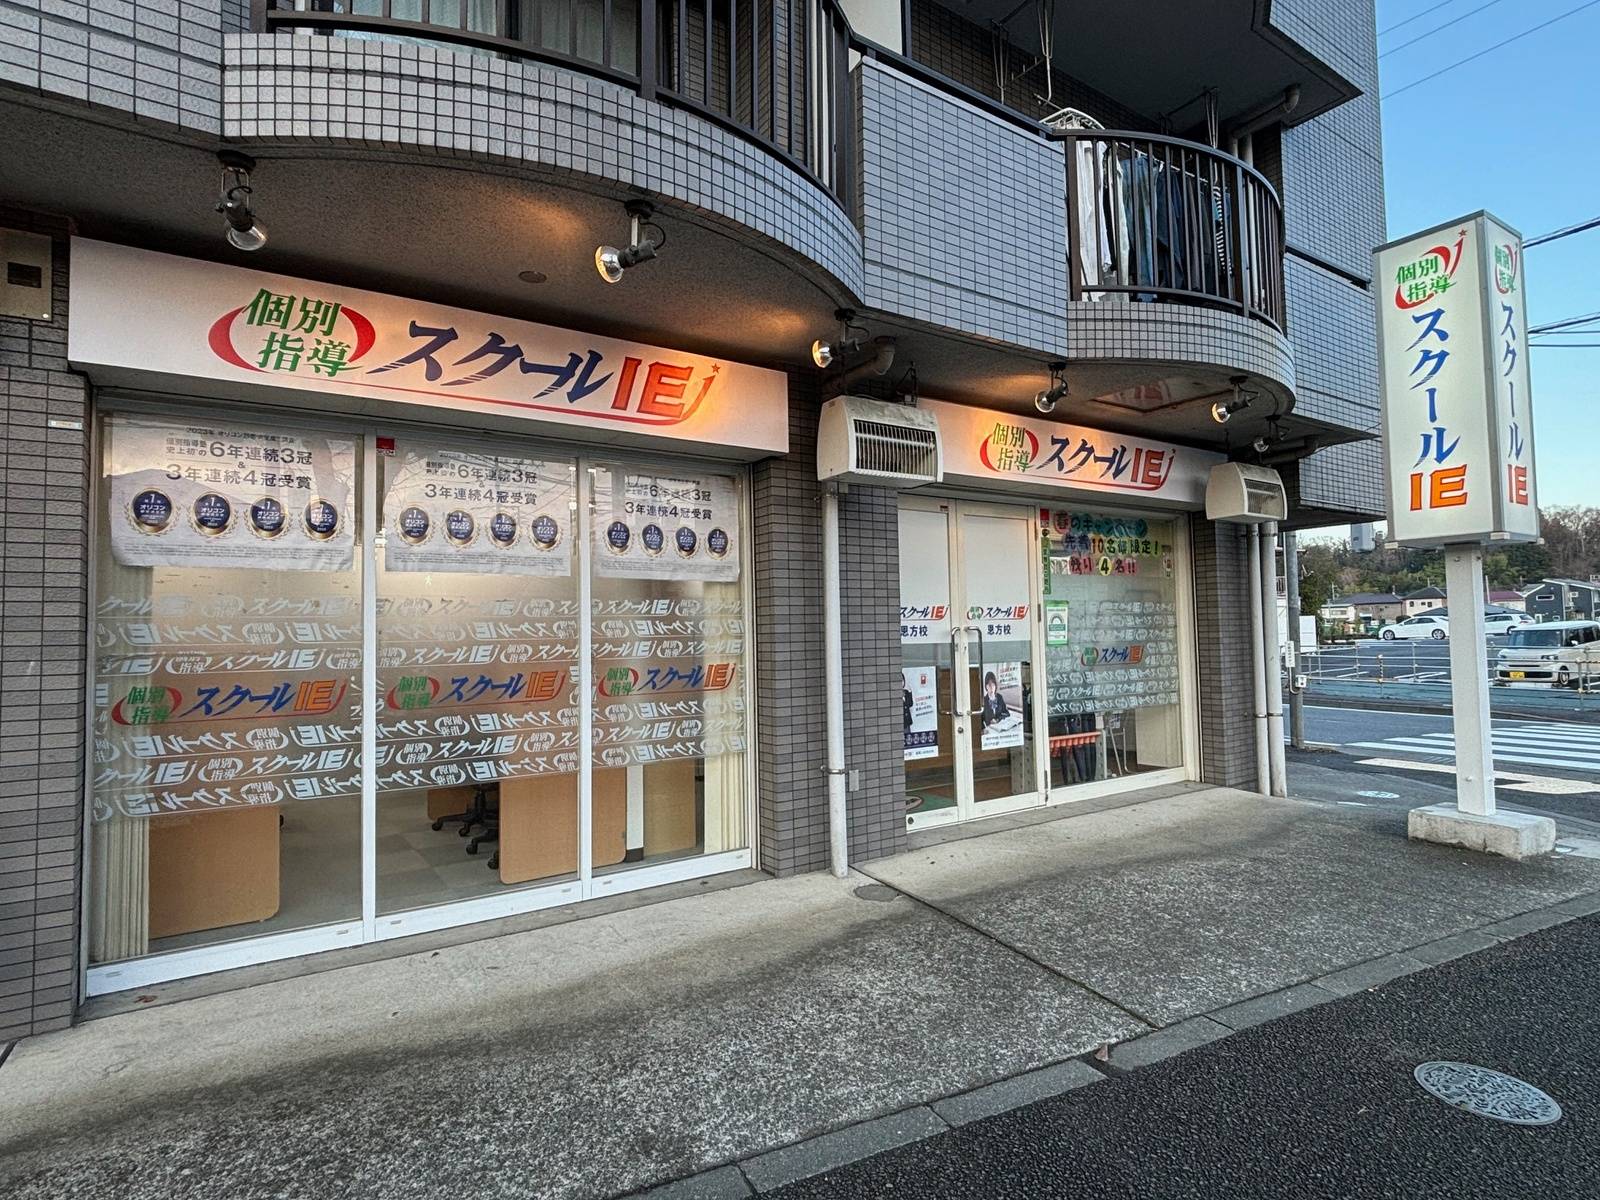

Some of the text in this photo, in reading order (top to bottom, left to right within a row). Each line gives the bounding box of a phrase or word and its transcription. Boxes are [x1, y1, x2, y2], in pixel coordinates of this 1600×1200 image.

[1395, 255, 1439, 283] 個別
[1406, 274, 1451, 302] 指導
[243, 287, 342, 335] 個別
[256, 331, 360, 378] 指導
[366, 319, 694, 414] スクールIE
[1405, 307, 1461, 469] スクール
[1500, 301, 1524, 462] スクール
[991, 421, 1026, 448] 個別
[209, 440, 313, 466] 6年連続3冠
[996, 446, 1031, 473] 指導
[1036, 434, 1165, 486] スクールIE
[165, 463, 312, 490] 3年連続4冠受賞
[1409, 463, 1468, 512] IE
[1507, 463, 1529, 506] IE
[424, 483, 537, 506] 3年連続4冠受賞
[624, 501, 713, 520] 3年連続4冠受賞
[984, 605, 1026, 619] スクールIE
[437, 671, 558, 703] スクールIE
[637, 662, 730, 691] スクールIE
[178, 679, 337, 718] スクールIE
